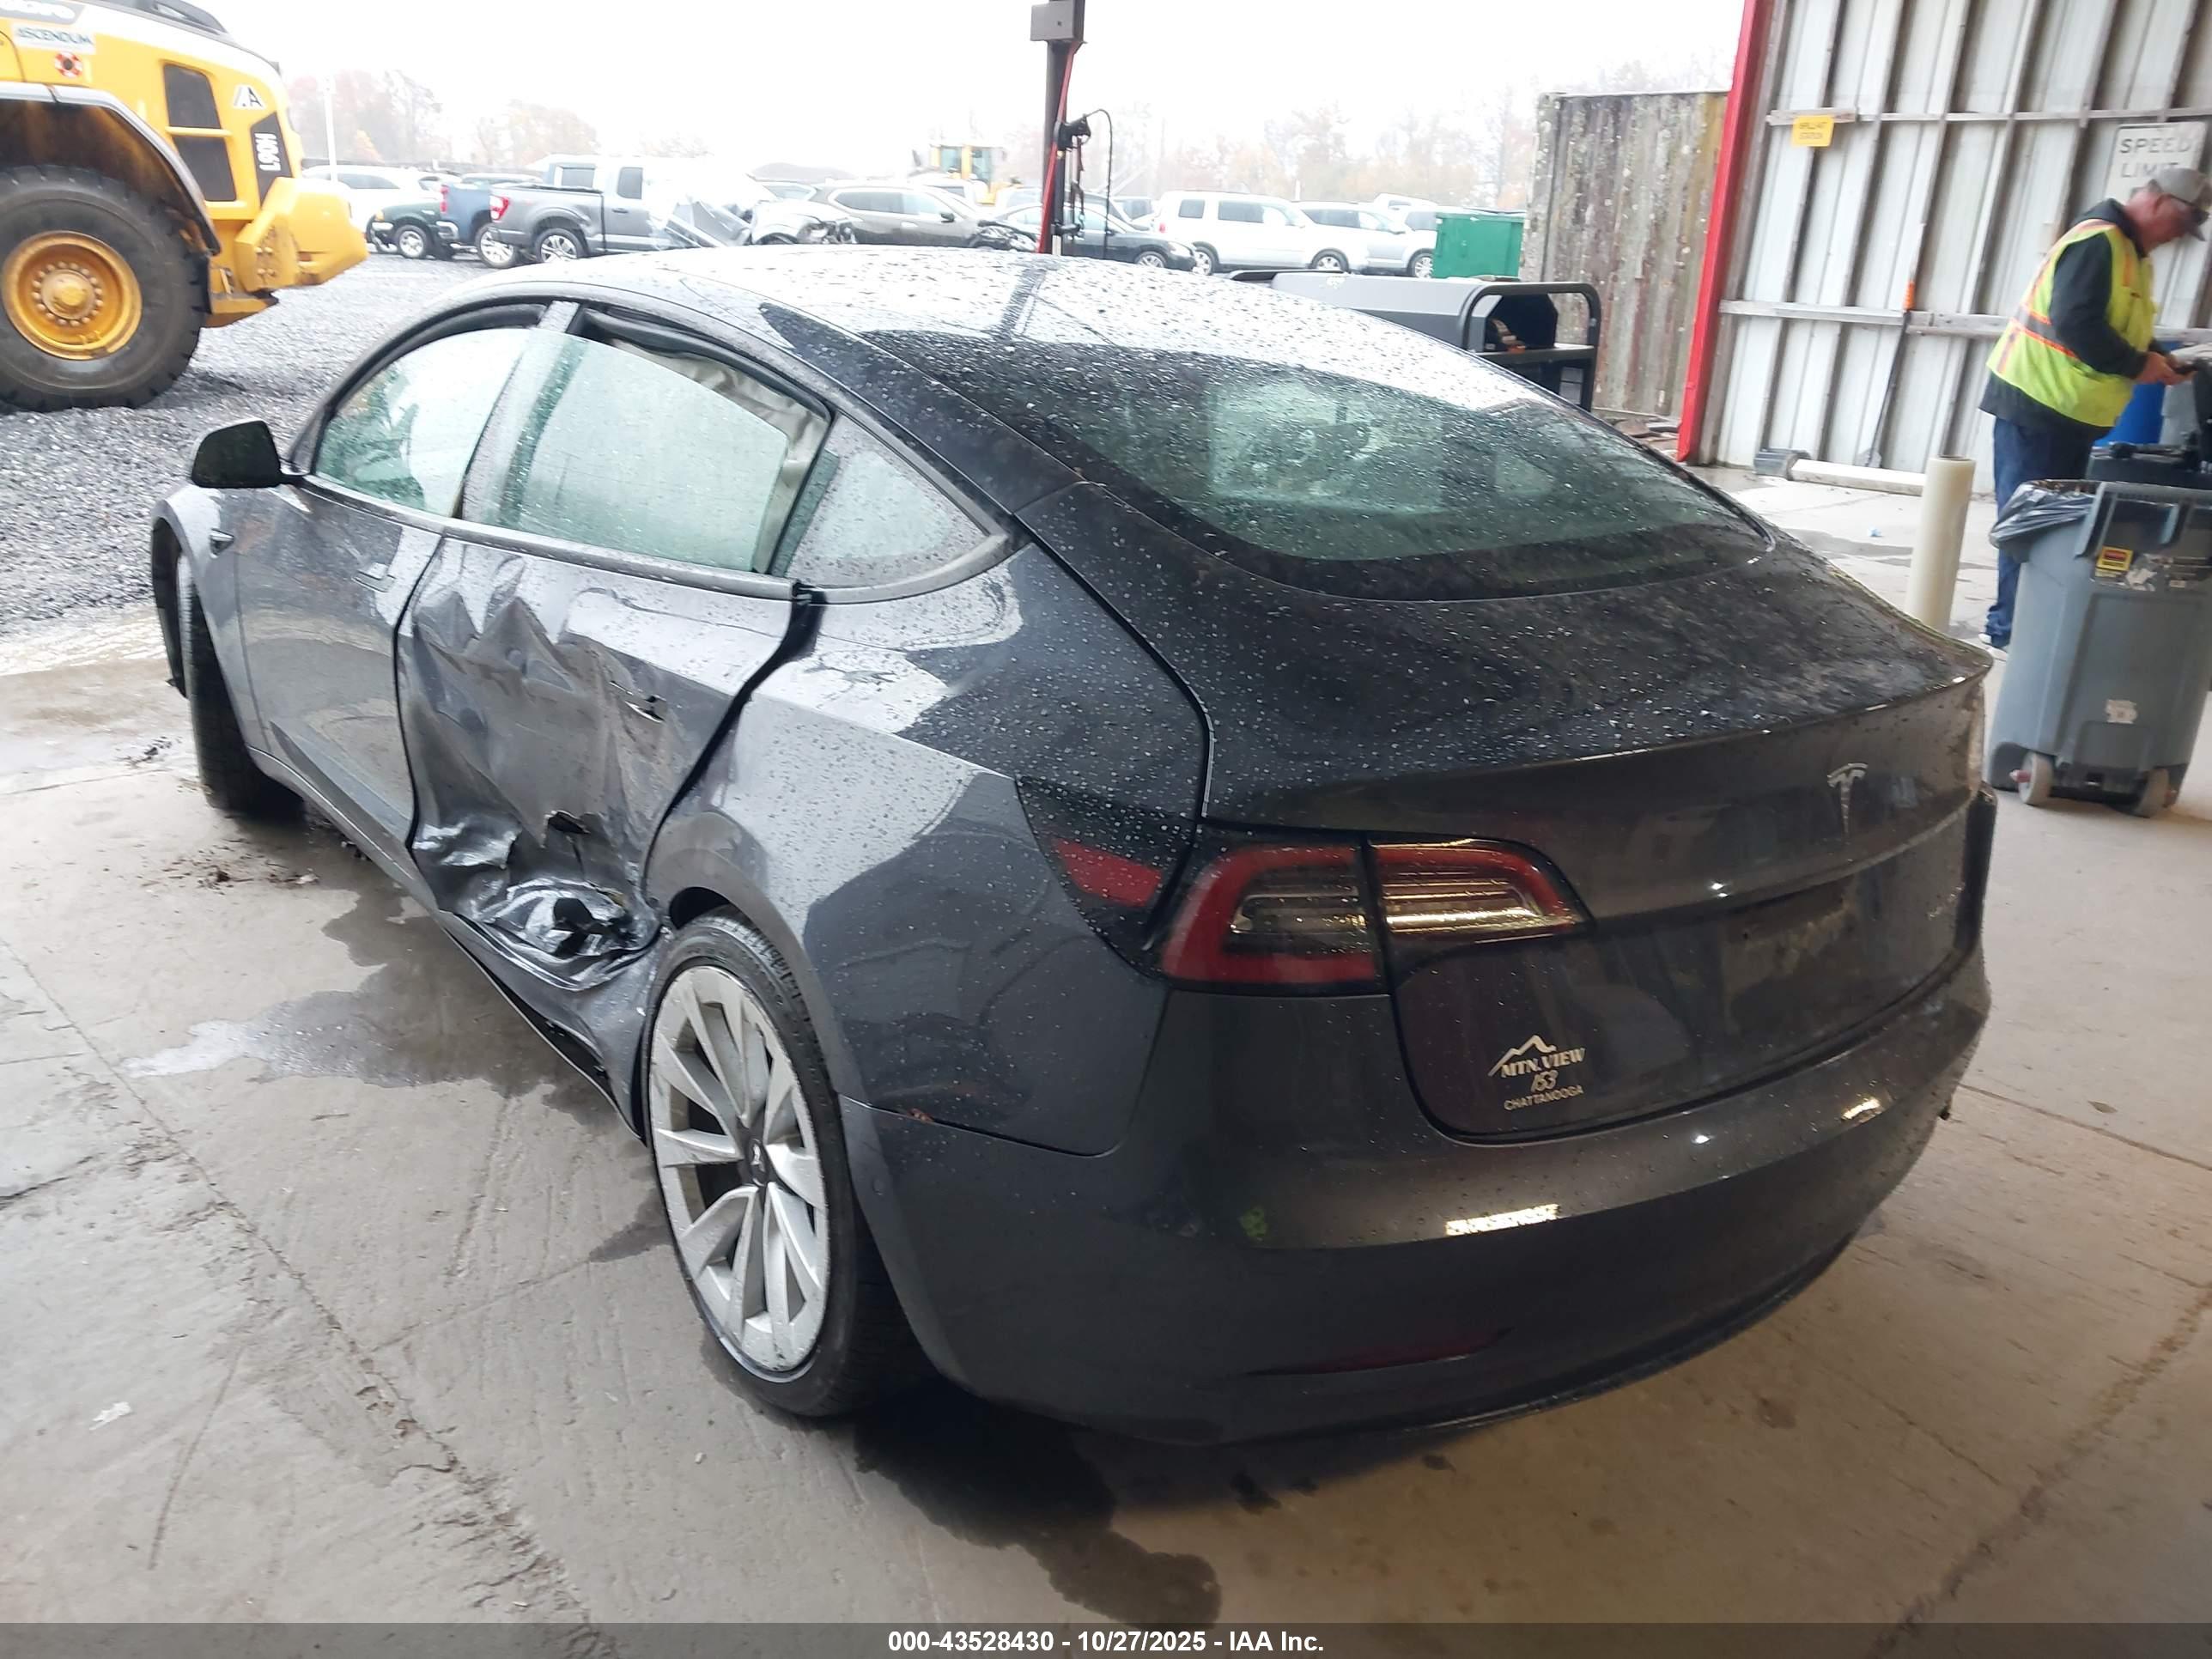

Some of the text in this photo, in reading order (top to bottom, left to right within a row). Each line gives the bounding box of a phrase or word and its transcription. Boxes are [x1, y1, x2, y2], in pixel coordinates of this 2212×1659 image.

[2118, 137, 2191, 155] SPEED
[1540, 1047, 1586, 1069] VIEW
[1504, 1085, 1585, 1111] CHATTANOOGA
